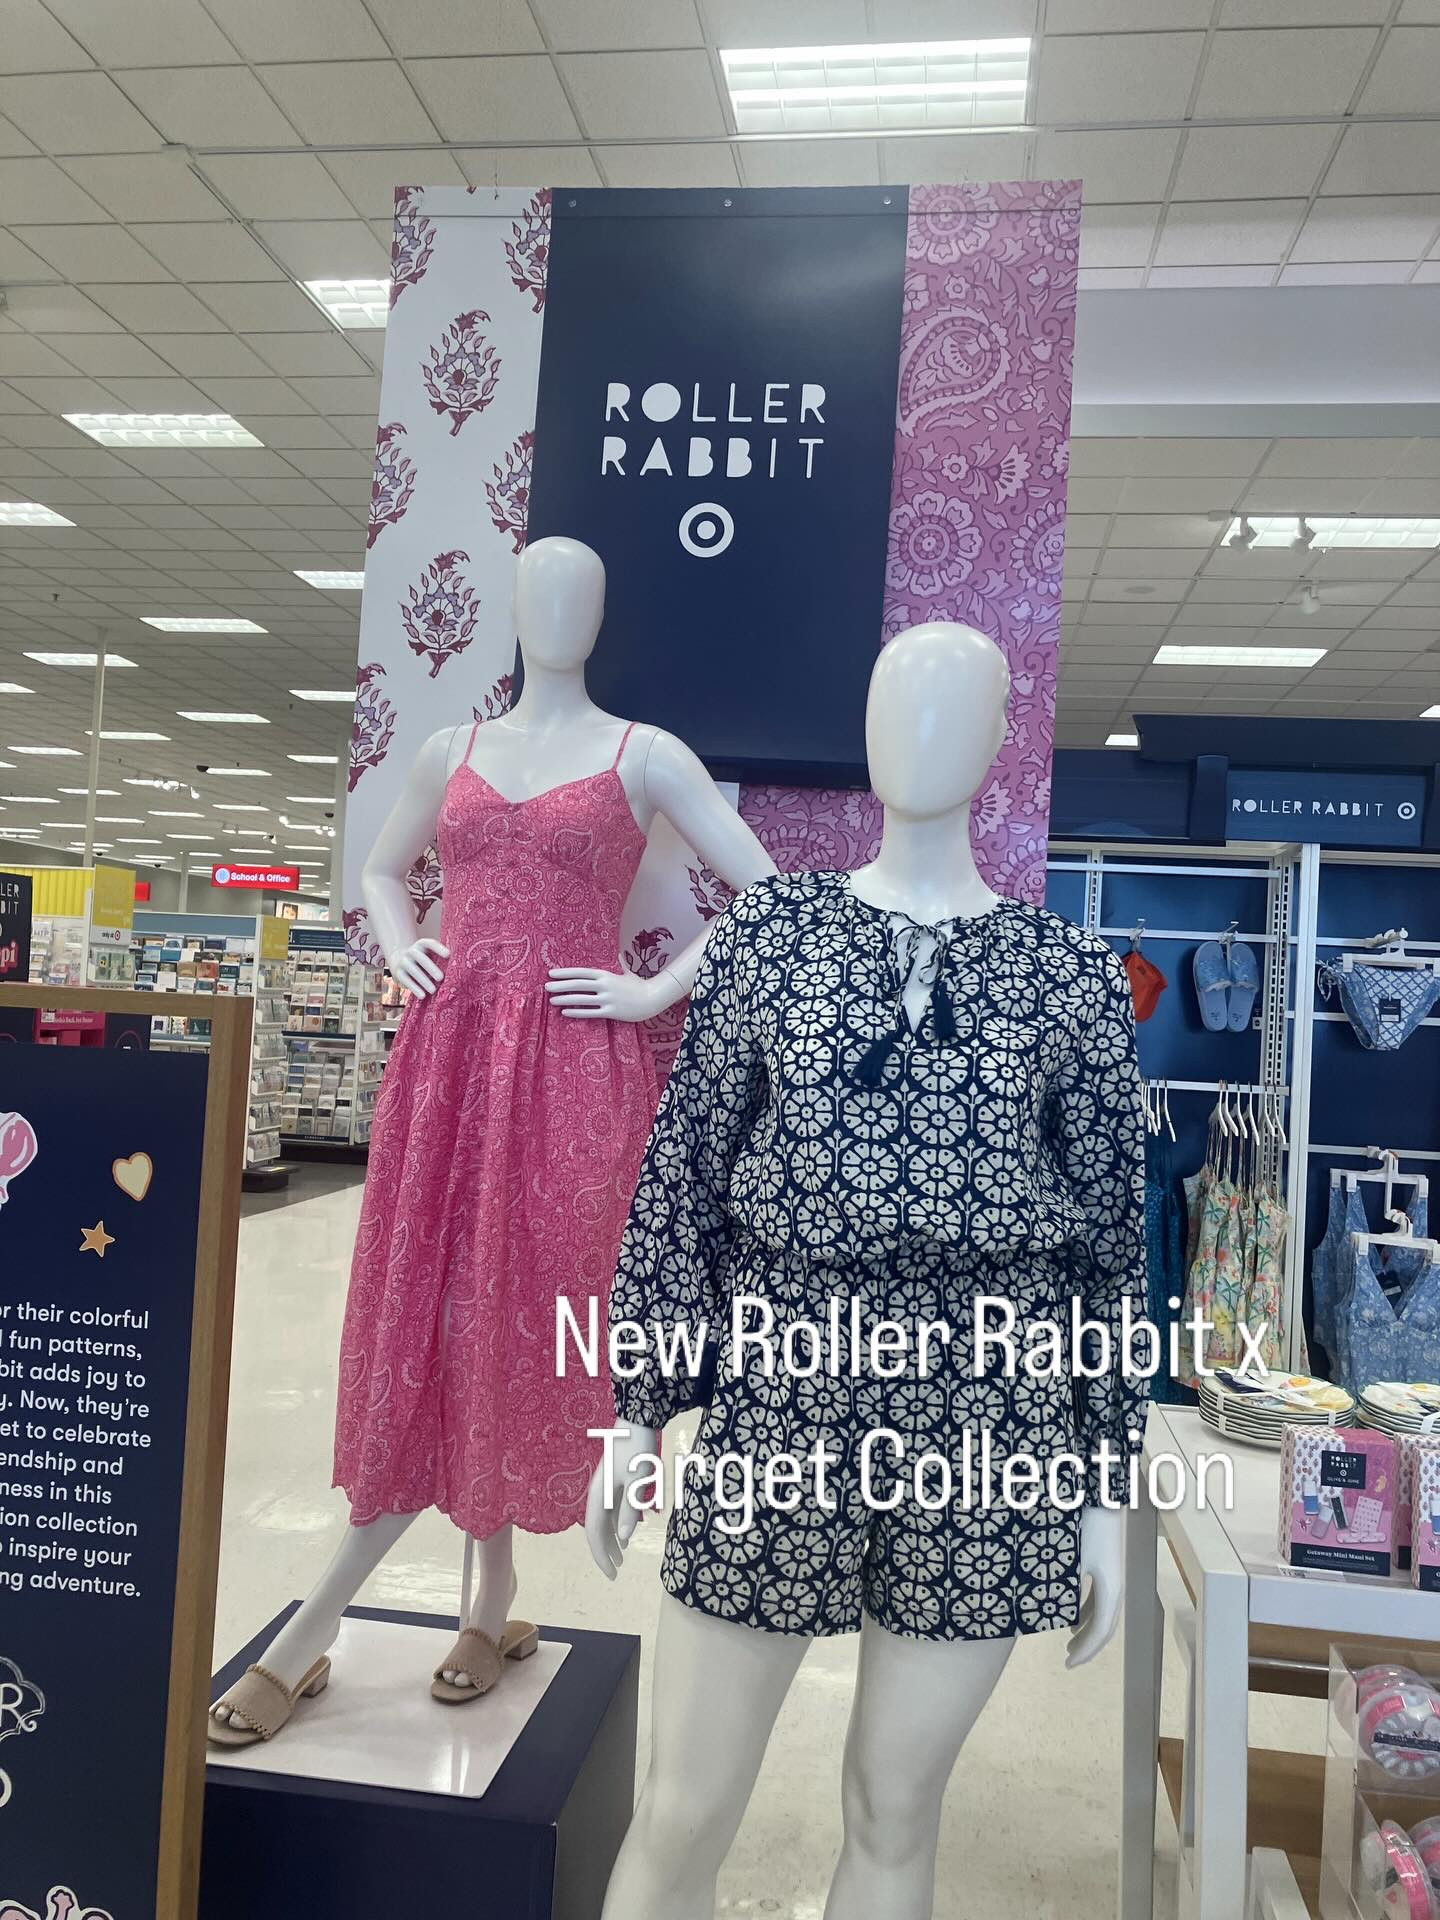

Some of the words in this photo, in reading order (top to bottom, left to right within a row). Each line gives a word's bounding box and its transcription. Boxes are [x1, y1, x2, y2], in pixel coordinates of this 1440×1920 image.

[605, 382, 826, 424] ROLLER
[601, 436, 824, 479] RABBIT
[1232, 798, 1303, 814] ROLLER
[1312, 801, 1384, 817] RABBIT
[230, 871, 259, 882] School
[259, 873, 265, 882] &
[266, 873, 291, 883] Office
[17, 1301, 65, 1323] their
[69, 1306, 149, 1329] colorful
[9, 1329, 42, 1350] fun
[48, 1336, 142, 1360] patterns,
[0, 1358, 24, 1379] bit
[29, 1362, 81, 1383] adds
[84, 1365, 118, 1390] joy
[125, 1370, 146, 1388] to
[20, 1389, 70, 1414] Now,
[76, 1394, 150, 1421] they're
[0, 1420, 20, 1438] et
[25, 1421, 47, 1440] to
[52, 1424, 151, 1448] celebrate
[82, 1456, 124, 1476] and
[0, 1482, 44, 1499] ness
[49, 1480, 68, 1501] in
[73, 1483, 112, 1505] this
[35, 1511, 138, 1537] collection
[9, 1536, 78, 1564] inspire
[83, 1549, 132, 1569] your
[1306, 1548, 1333, 1558] Getaway
[1333, 1551, 1348, 1560] Mini
[1365, 1554, 1375, 1562] Set
[29, 1570, 141, 1597] adventure.
